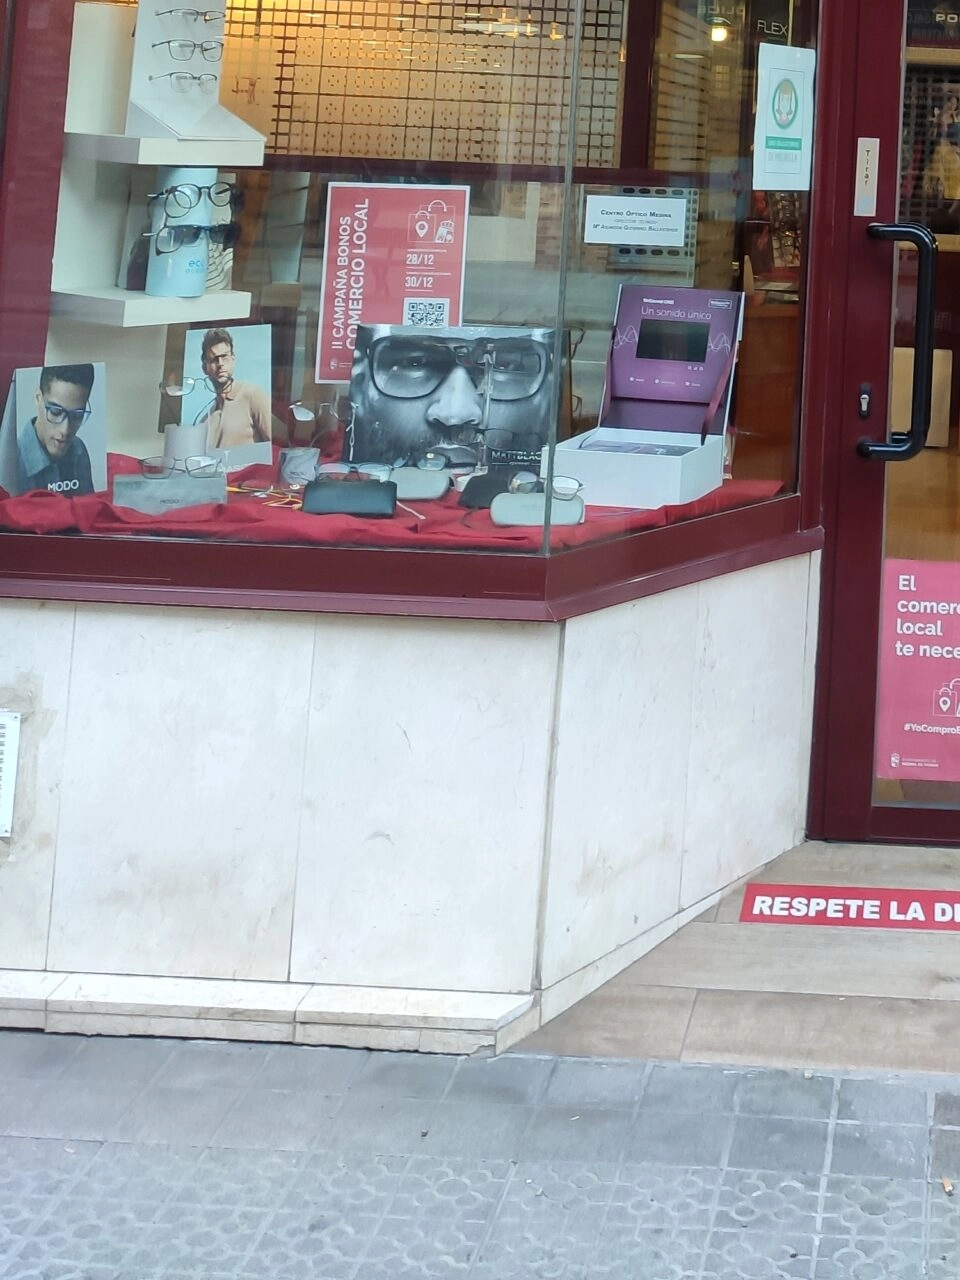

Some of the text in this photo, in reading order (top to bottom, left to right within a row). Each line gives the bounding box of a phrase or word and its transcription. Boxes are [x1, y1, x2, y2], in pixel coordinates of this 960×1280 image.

[757, 20, 788, 36] FLEX
[336, 215, 351, 266] BONOS
[406, 253, 434, 265] 28/12
[345, 198, 369, 350] COMERCIO LOCAL
[404, 276, 433, 288] 30/12
[332, 269, 349, 339] CAMPAÑA
[641, 306, 655, 316] Un
[656, 308, 686, 319] sonido
[47, 479, 80, 492] MODO
[898, 575, 917, 591] El
[896, 618, 944, 636] local
[895, 640, 915, 657] te
[752, 895, 881, 920] RESPETE
[888, 899, 925, 922] LA
